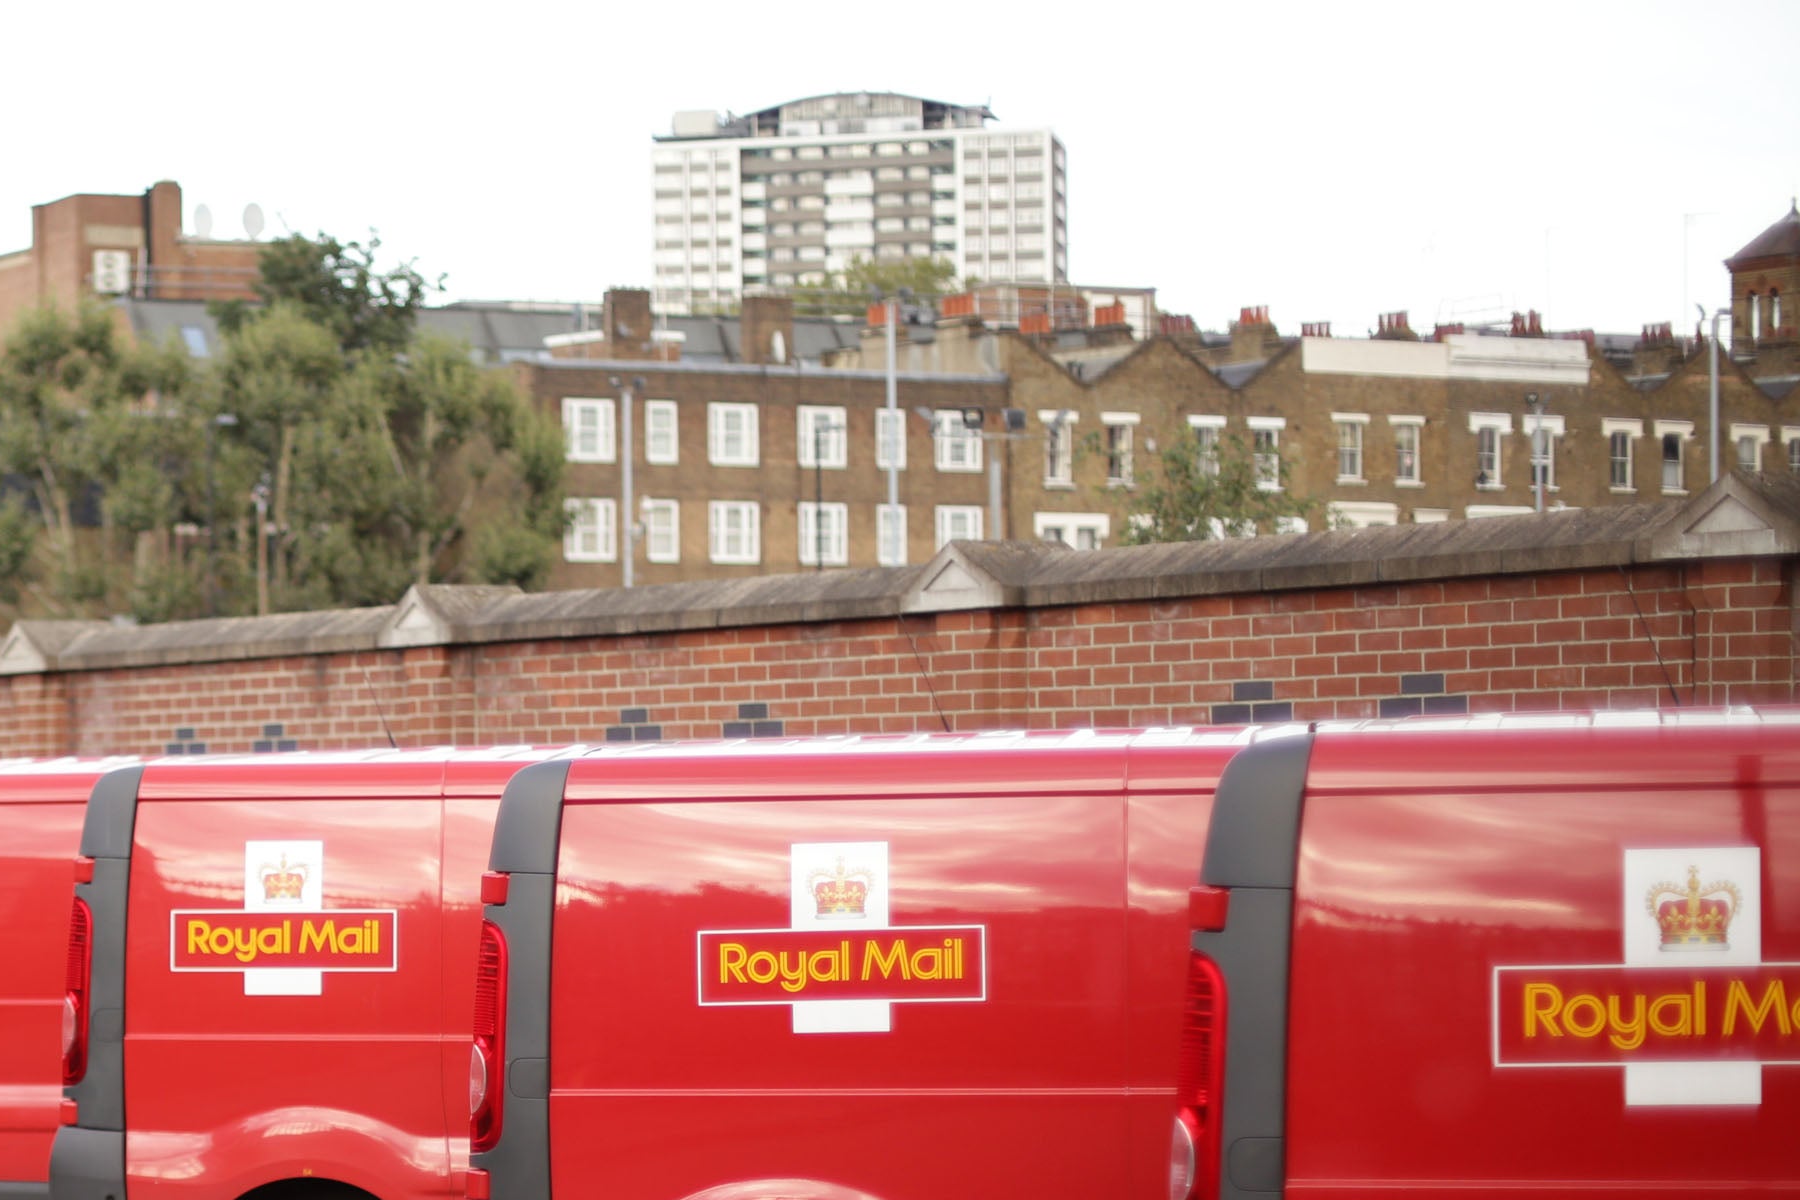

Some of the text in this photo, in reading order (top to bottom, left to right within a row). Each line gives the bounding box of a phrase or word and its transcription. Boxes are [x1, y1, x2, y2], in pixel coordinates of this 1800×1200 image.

[188, 919, 380, 962] Royal Mail
[719, 938, 964, 992] Royal Mail
[1525, 979, 1800, 1050] Royal M
